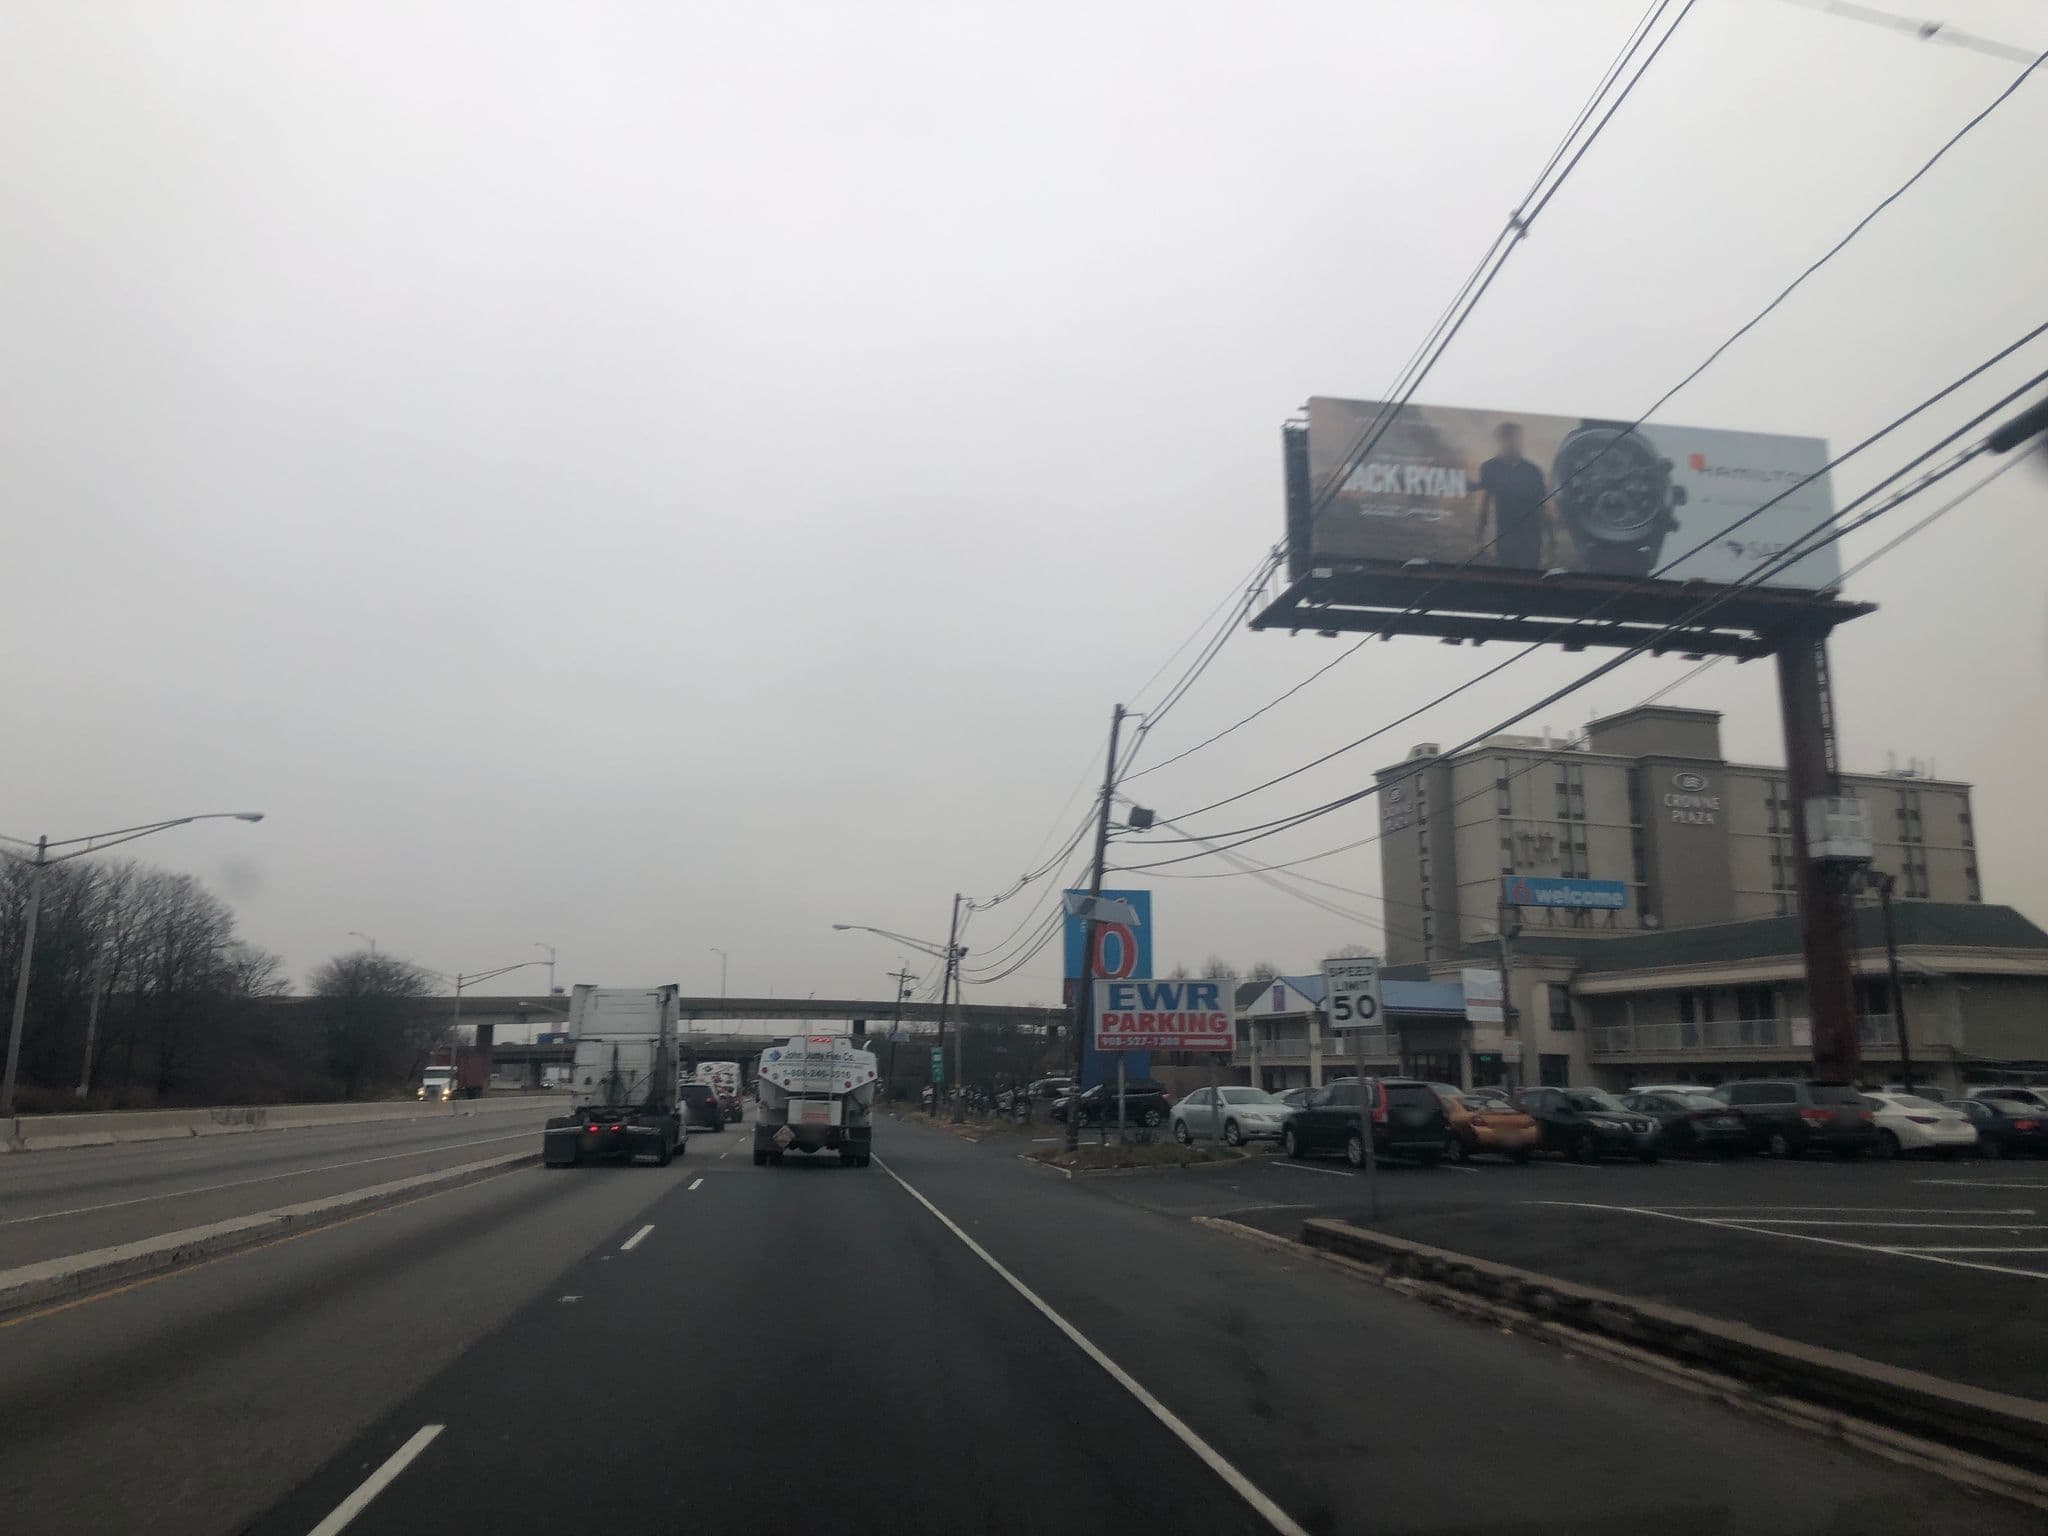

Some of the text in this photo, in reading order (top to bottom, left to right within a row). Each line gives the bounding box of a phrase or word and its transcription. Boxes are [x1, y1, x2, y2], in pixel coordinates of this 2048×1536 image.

[1404, 465, 1467, 497] RYAN
[1535, 886, 1625, 906] welcome
[1329, 966, 1374, 978] SPEED
[1335, 980, 1370, 992] LIMIT
[1109, 983, 1220, 1011] EWR
[1334, 994, 1377, 1021] 50
[1102, 1013, 1228, 1033] PARKING
